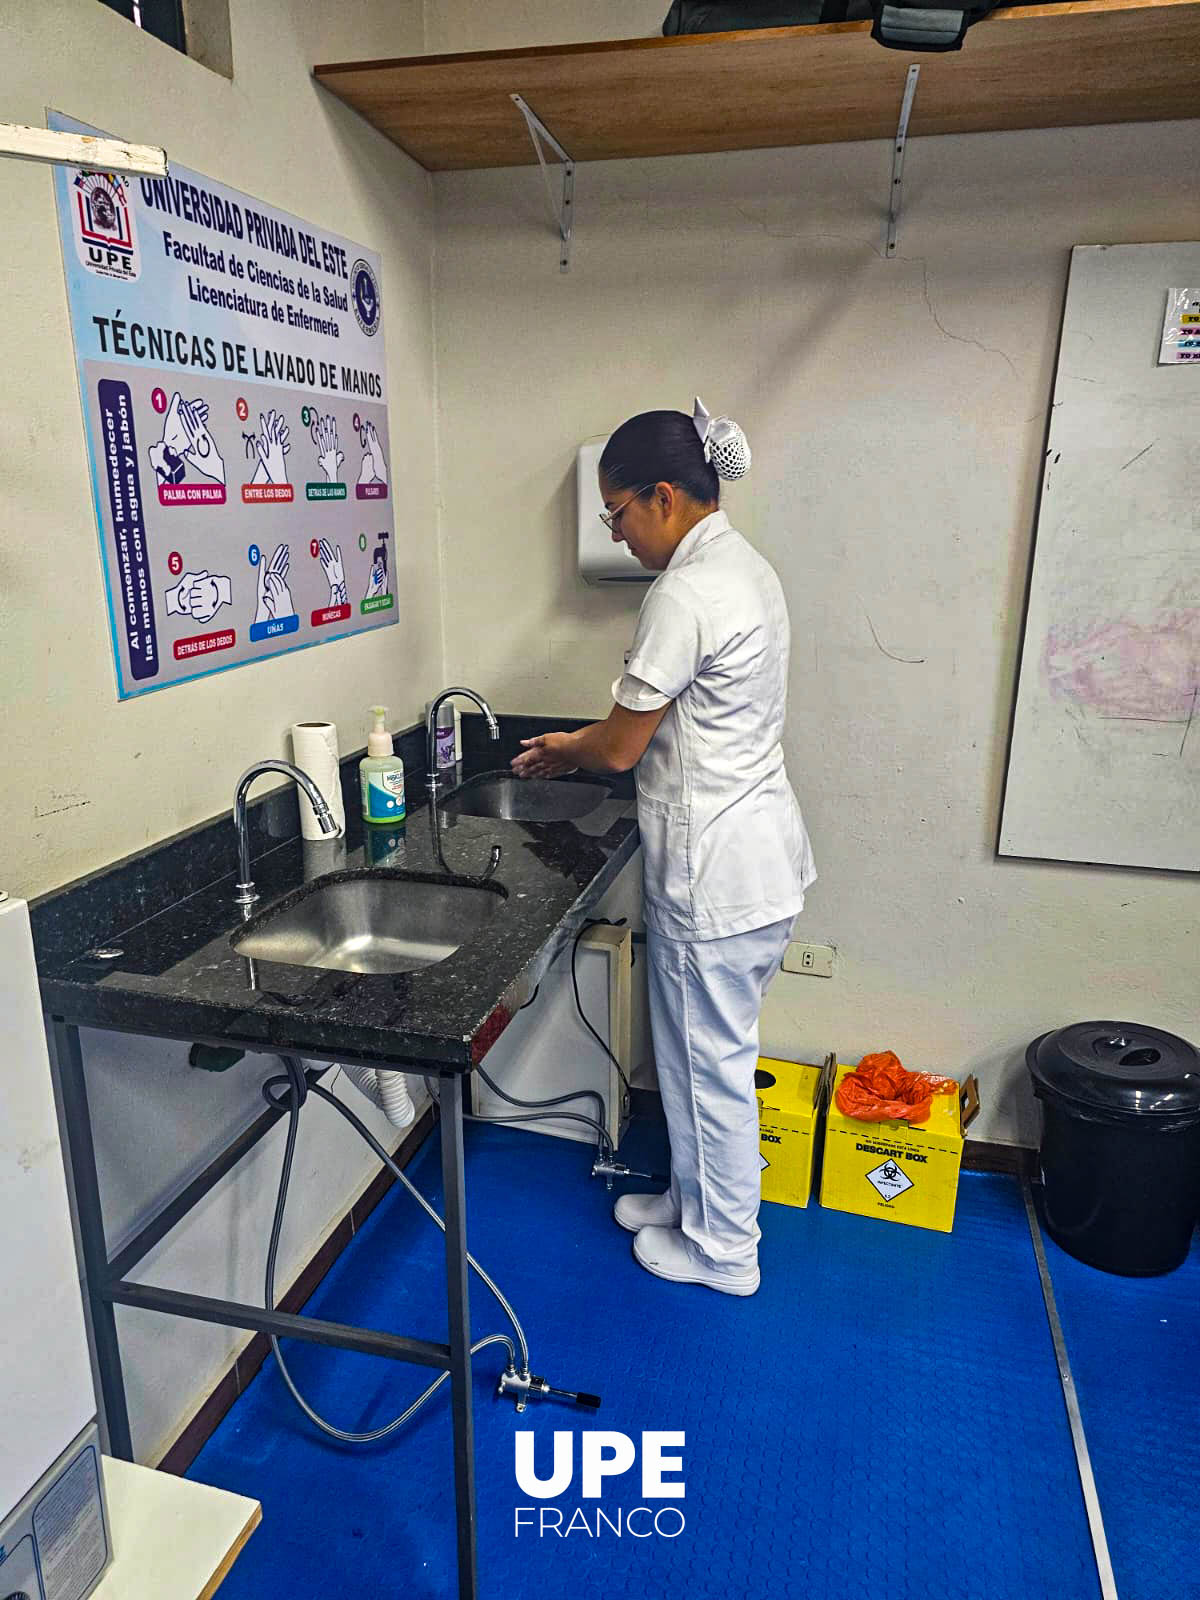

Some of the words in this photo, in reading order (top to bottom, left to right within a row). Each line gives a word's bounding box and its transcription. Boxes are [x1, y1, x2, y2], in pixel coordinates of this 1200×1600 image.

[140, 177, 243, 239] UNIVERSIDAD
[245, 208, 299, 262] PRIVADA
[298, 231, 322, 270] DEL
[321, 241, 349, 280] ESTE
[88, 246, 132, 271] UPE
[162, 231, 226, 274] Facultad
[228, 254, 244, 279] de
[246, 260, 295, 295] Ciencias
[297, 277, 310, 300] de
[311, 281, 322, 304] la
[323, 286, 349, 312] Salud
[188, 275, 269, 320] Licenciatura
[271, 300, 285, 324] de
[92, 308, 217, 370] TÉCNICAS
[222, 341, 249, 374] DE
[252, 347, 315, 387] LAVADO
[319, 361, 339, 390] DE
[341, 366, 383, 399] MANOS
[155, 394, 164, 408] 1
[238, 402, 246, 417] 2
[118, 394, 133, 452] jabón
[303, 410, 310, 423] 3
[106, 408, 124, 522] humedecer
[125, 456, 134, 467] y
[127, 474, 138, 522] agua
[163, 489, 187, 501] PALMA
[187, 489, 201, 500] CON
[202, 489, 223, 500] PALMA
[244, 488, 264, 499] ENTRE
[264, 488, 274, 498] LOS
[274, 488, 291, 498] DEDOS
[133, 527, 143, 562] con
[311, 542, 317, 554] 7
[171, 558, 179, 571] 5
[251, 549, 258, 562] 6
[120, 528, 137, 626] comenzar,
[138, 567, 151, 629] manos
[267, 622, 284, 634] UÑAS
[130, 631, 140, 650] Al
[145, 634, 154, 661] las
[198, 640, 206, 651] DE
[206, 638, 216, 649] LOS
[216, 634, 233, 647] DEDOS
[761, 1133, 782, 1145] BOX
[856, 1142, 904, 1159] DESCART
[905, 1151, 929, 1164] BOX
